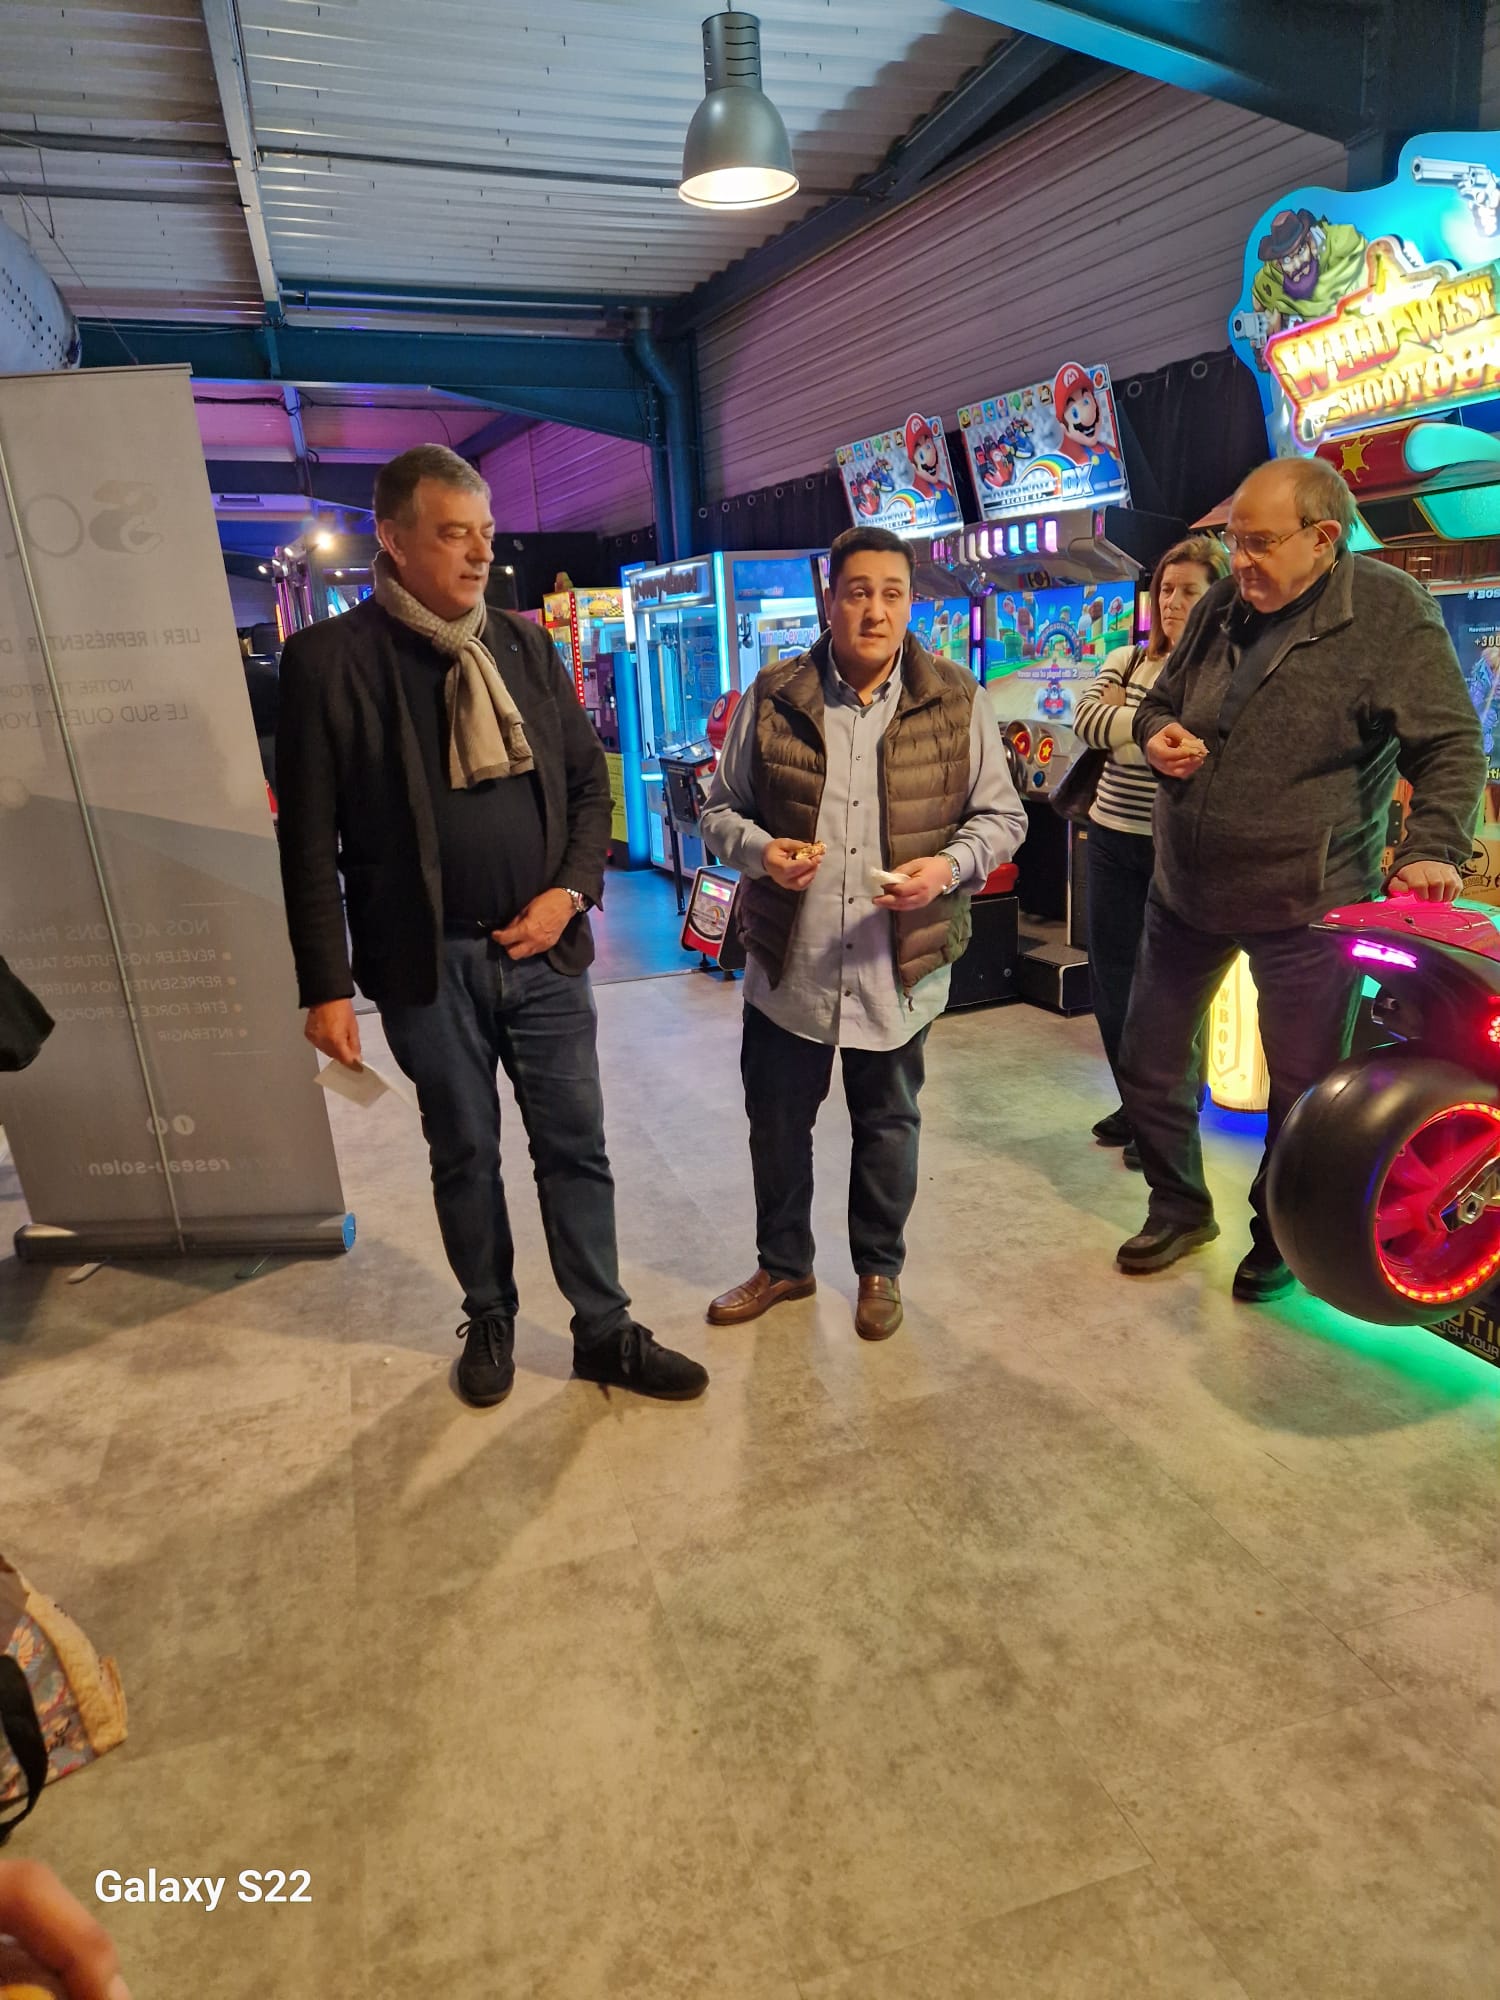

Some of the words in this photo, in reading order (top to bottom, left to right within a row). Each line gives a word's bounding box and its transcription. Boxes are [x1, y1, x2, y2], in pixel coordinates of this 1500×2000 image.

[1403, 274, 1495, 345] WEST
[1062, 464, 1094, 500] DX
[915, 498, 938, 525] DX
[1466, 1332, 1500, 1358] YOUR
